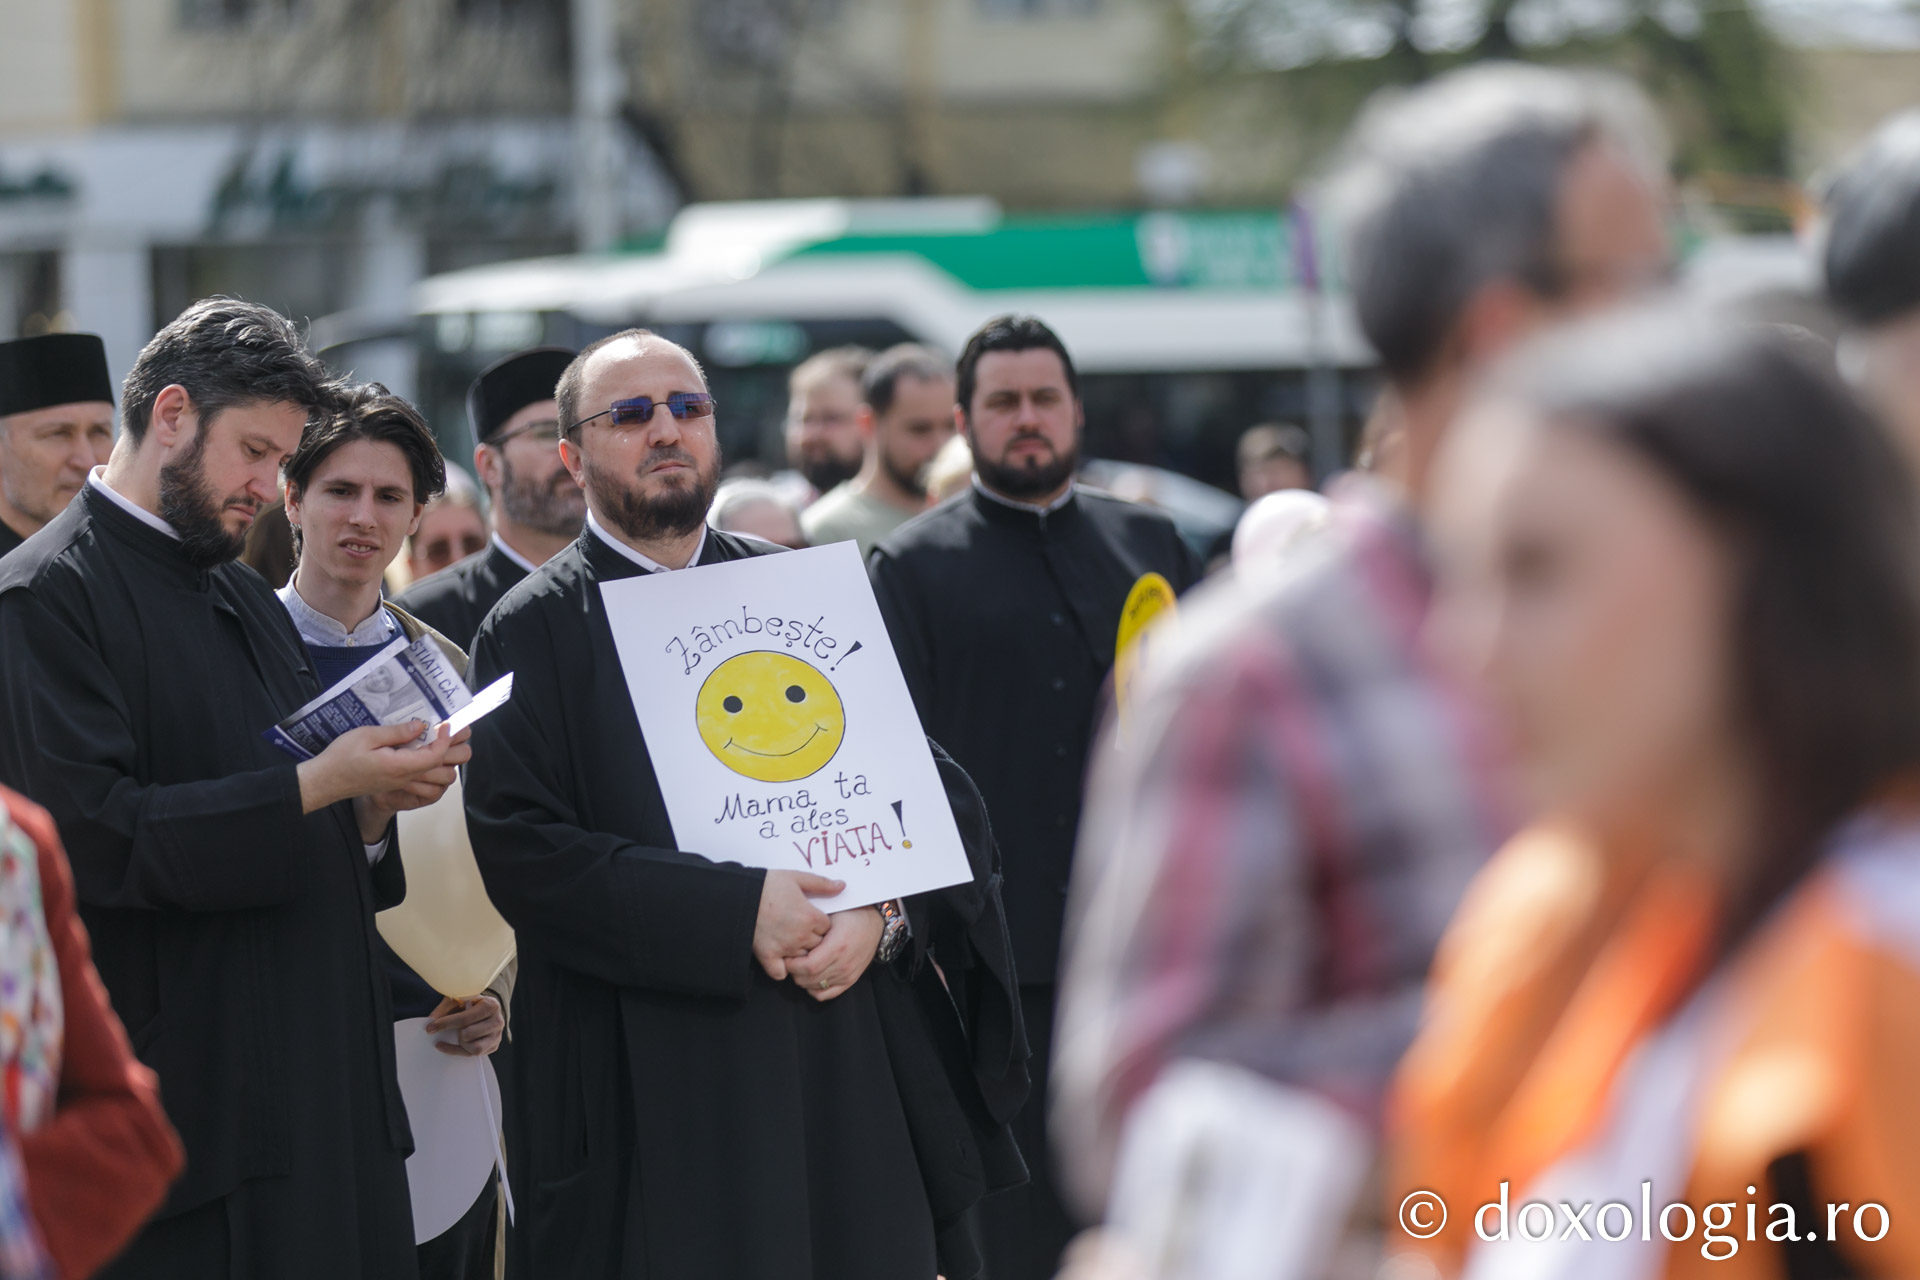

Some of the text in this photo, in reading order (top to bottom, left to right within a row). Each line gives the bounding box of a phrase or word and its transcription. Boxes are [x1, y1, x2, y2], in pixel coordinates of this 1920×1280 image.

[665, 605, 863, 676] Zâmbește!
[714, 771, 872, 824] Mama ta
[759, 808, 849, 839] a ales
